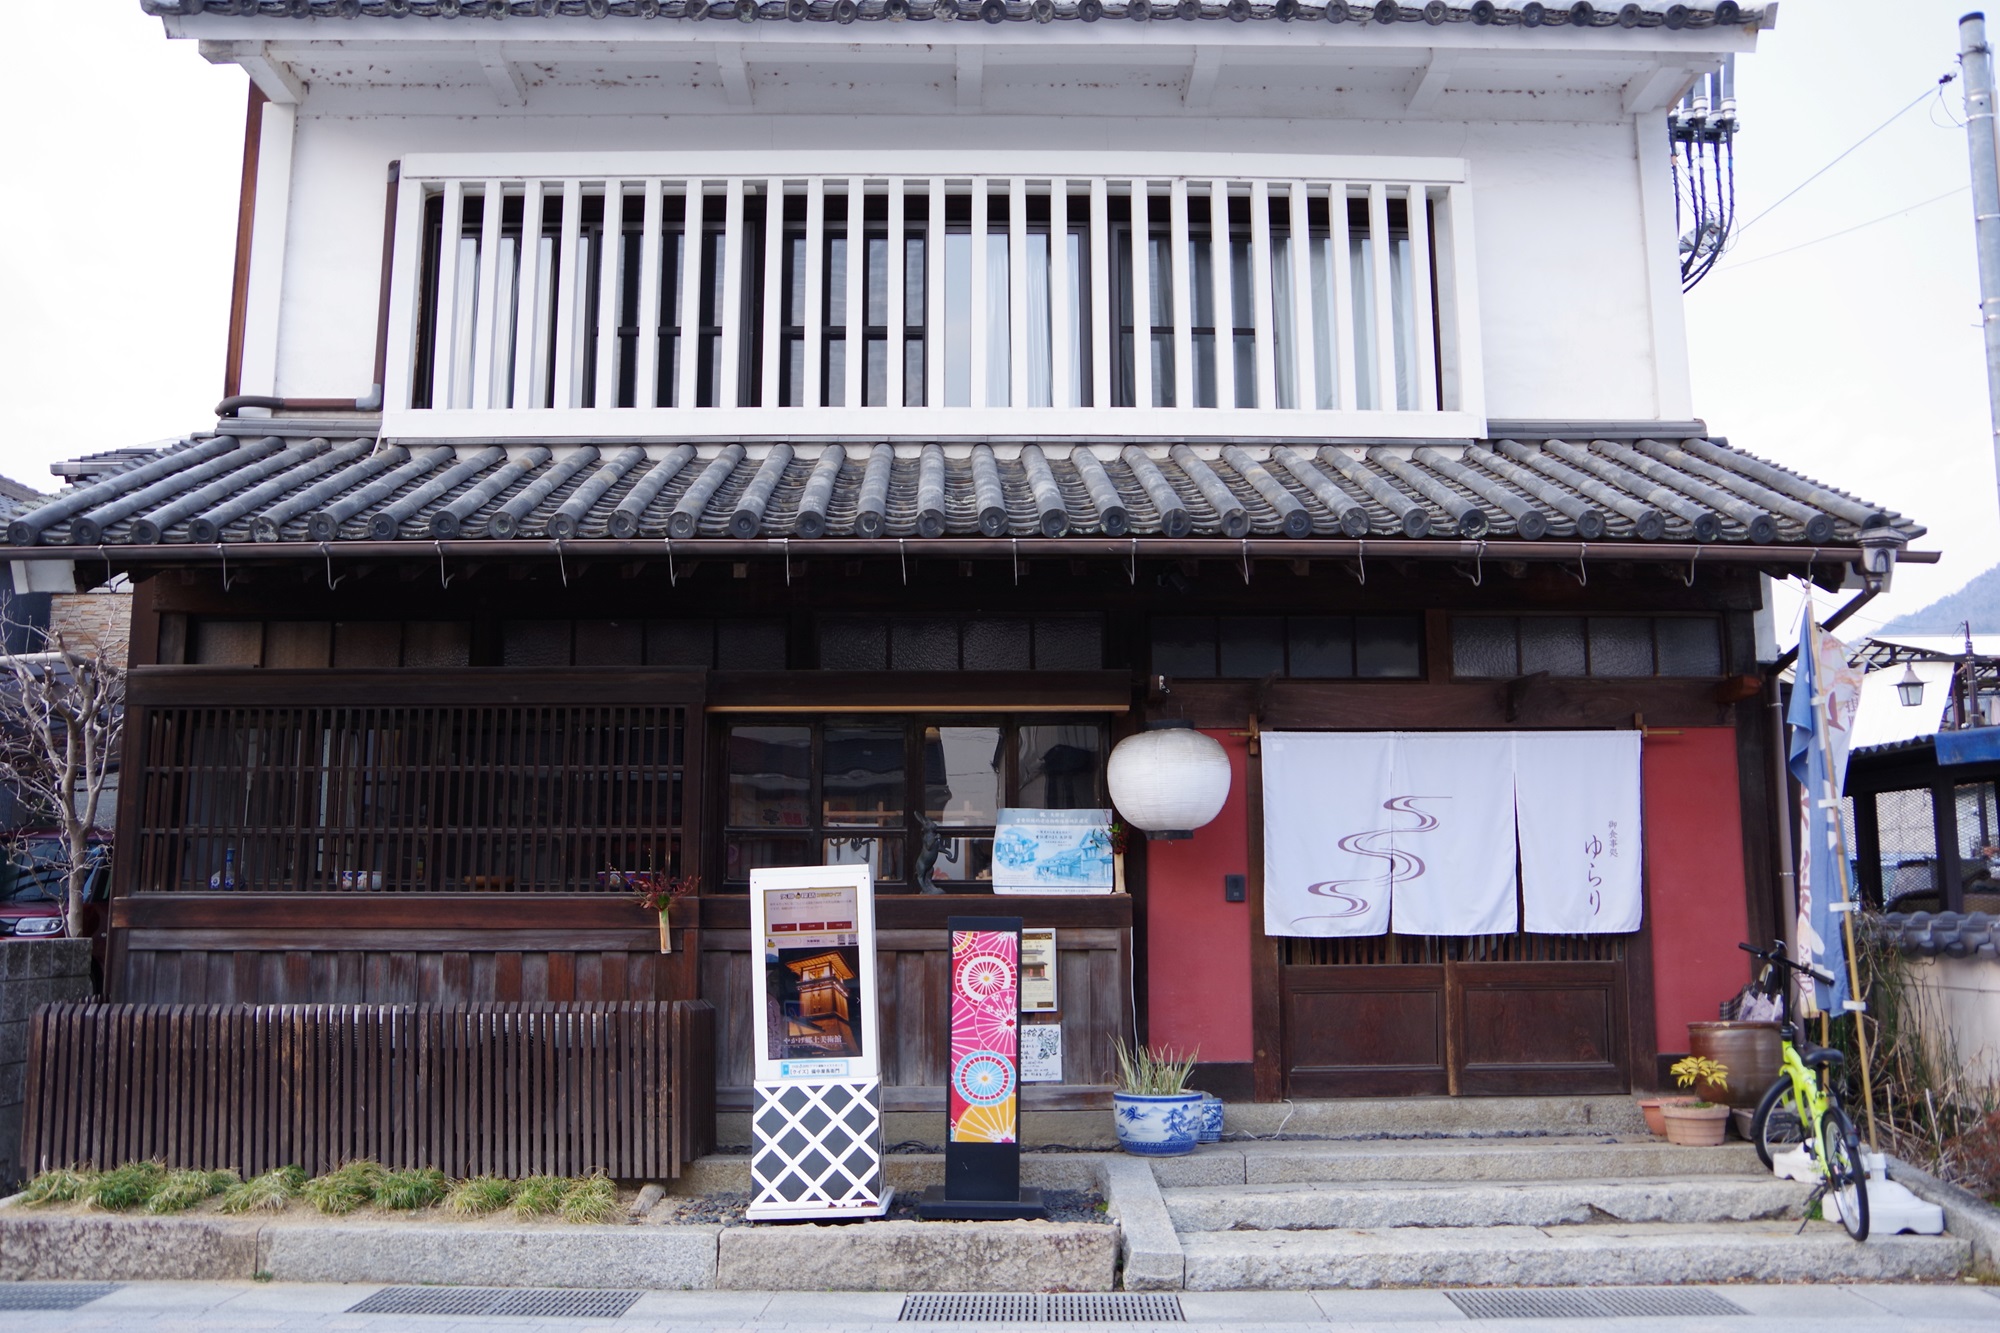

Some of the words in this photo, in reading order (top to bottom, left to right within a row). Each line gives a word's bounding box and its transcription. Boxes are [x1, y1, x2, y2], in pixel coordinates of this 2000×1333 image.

[1608, 820, 1619, 858] 御食事処
[1584, 834, 1603, 916] ゆらり
[783, 1034, 842, 1045] やかげ郷土美術館
